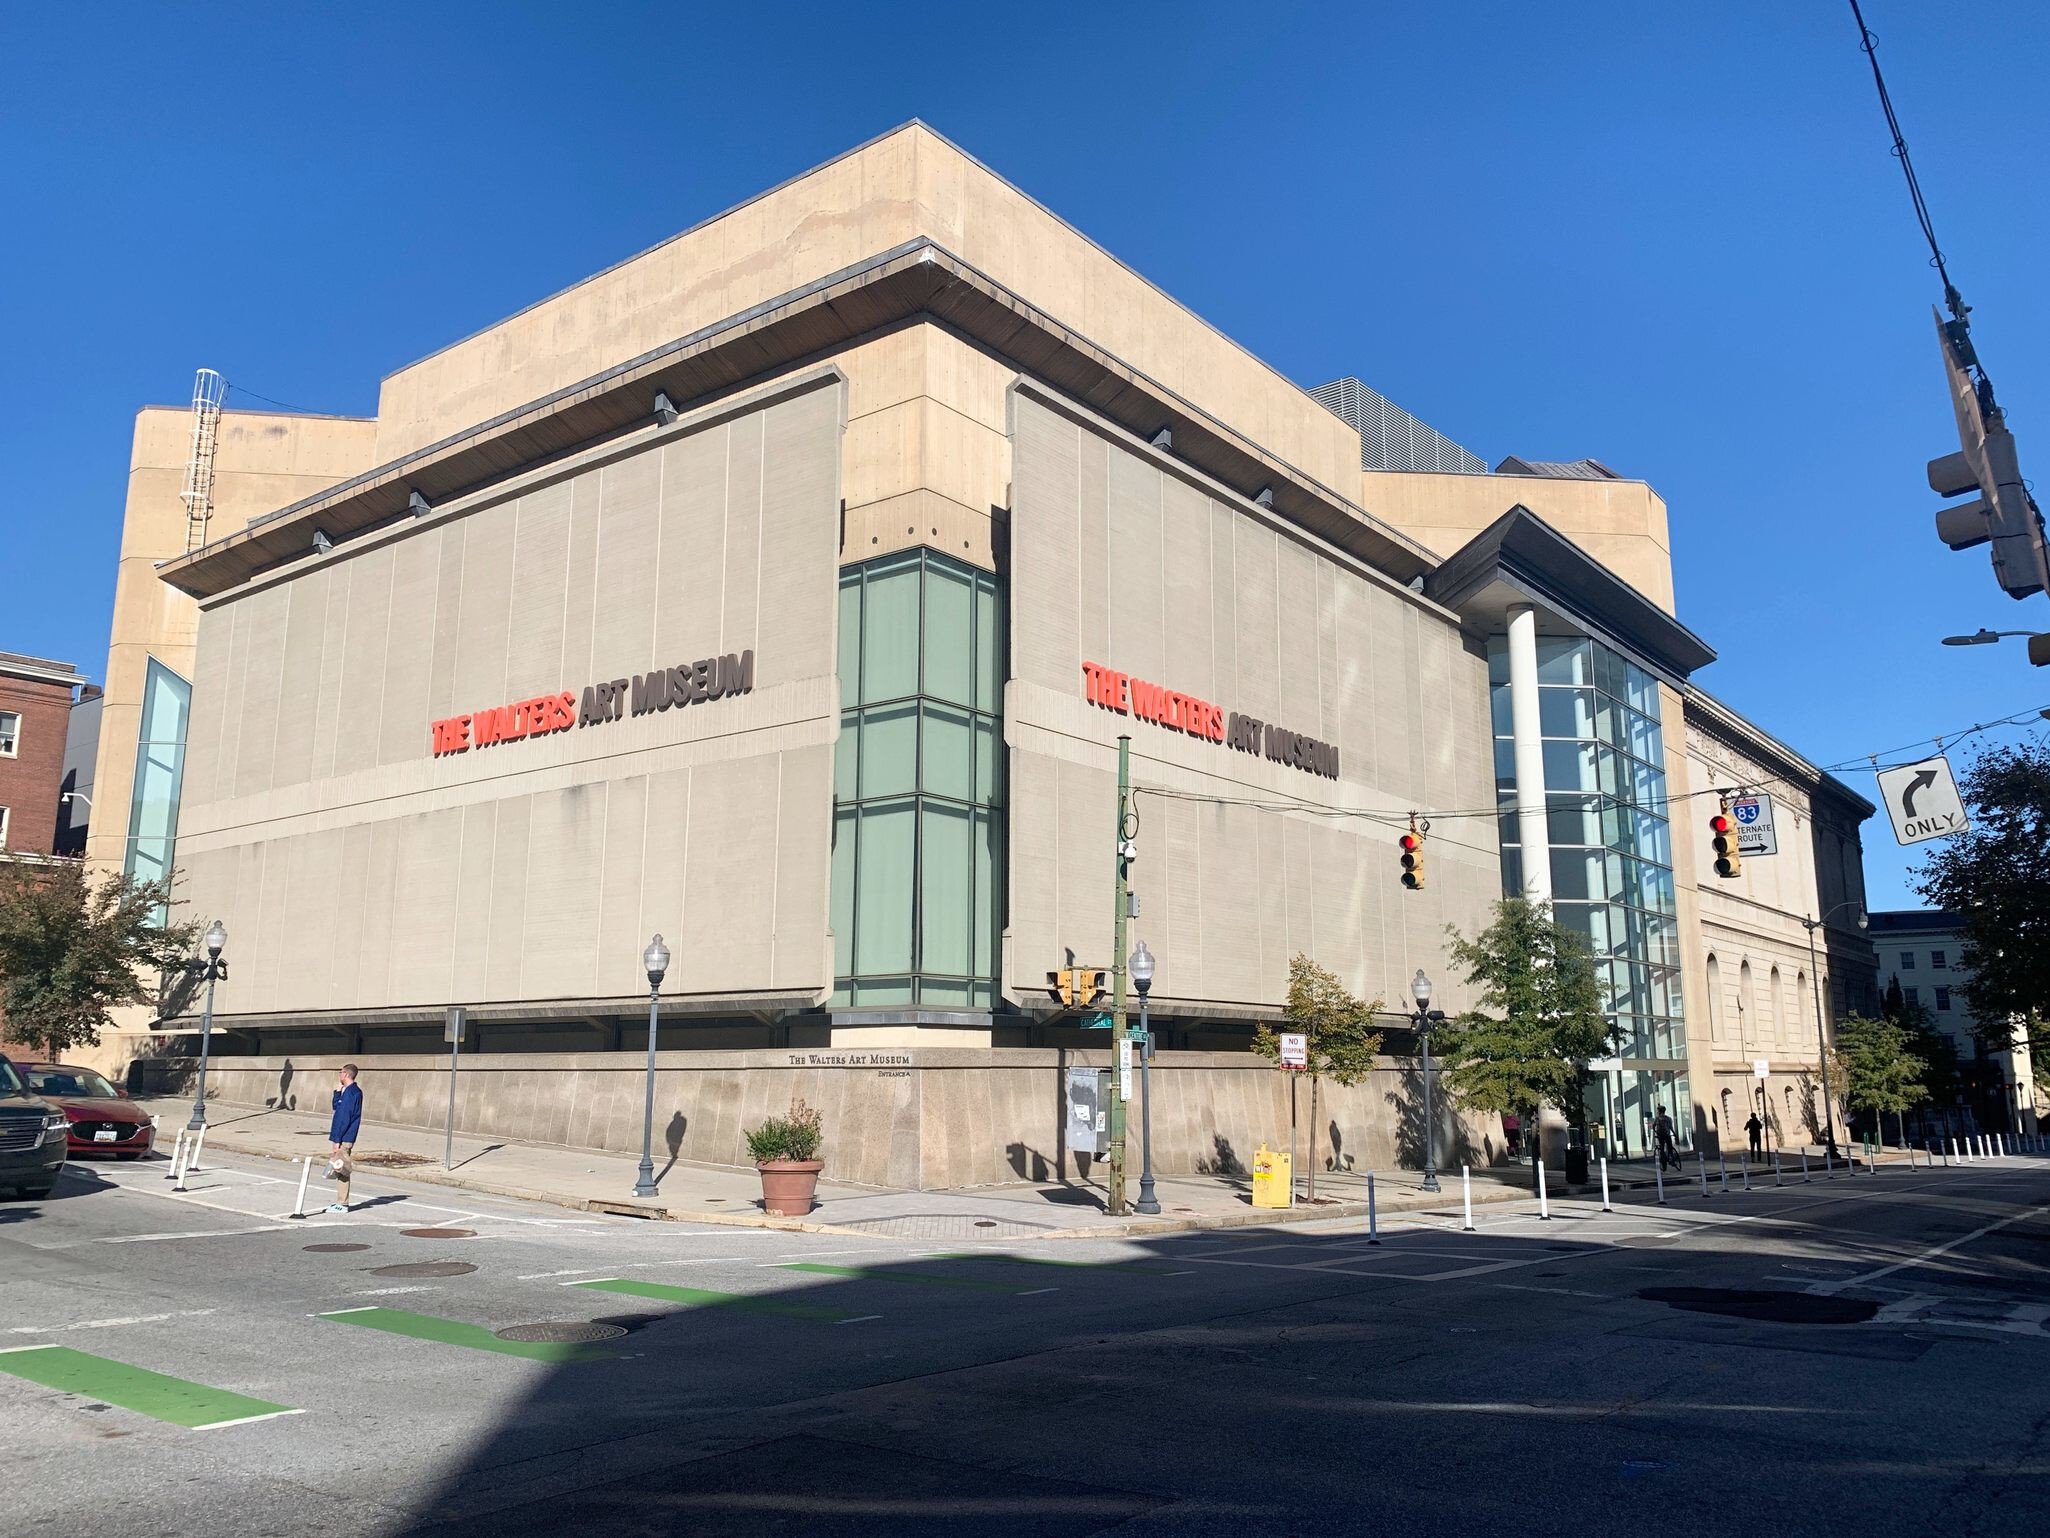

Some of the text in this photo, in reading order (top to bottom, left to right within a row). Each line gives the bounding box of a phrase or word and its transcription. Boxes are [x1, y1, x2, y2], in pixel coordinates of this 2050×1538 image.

[431, 649, 754, 759] THE WALTERS ART MUSEUM
[1081, 660, 1340, 781] THE WALTERS ART MUSEUM
[1737, 806, 1757, 820] 83
[1737, 824, 1772, 835] TERNATE
[1905, 812, 1957, 838] ONLY
[1737, 833, 1764, 843] ROUTE
[789, 1054, 910, 1065] THE WALTERS ART MUSEUM
